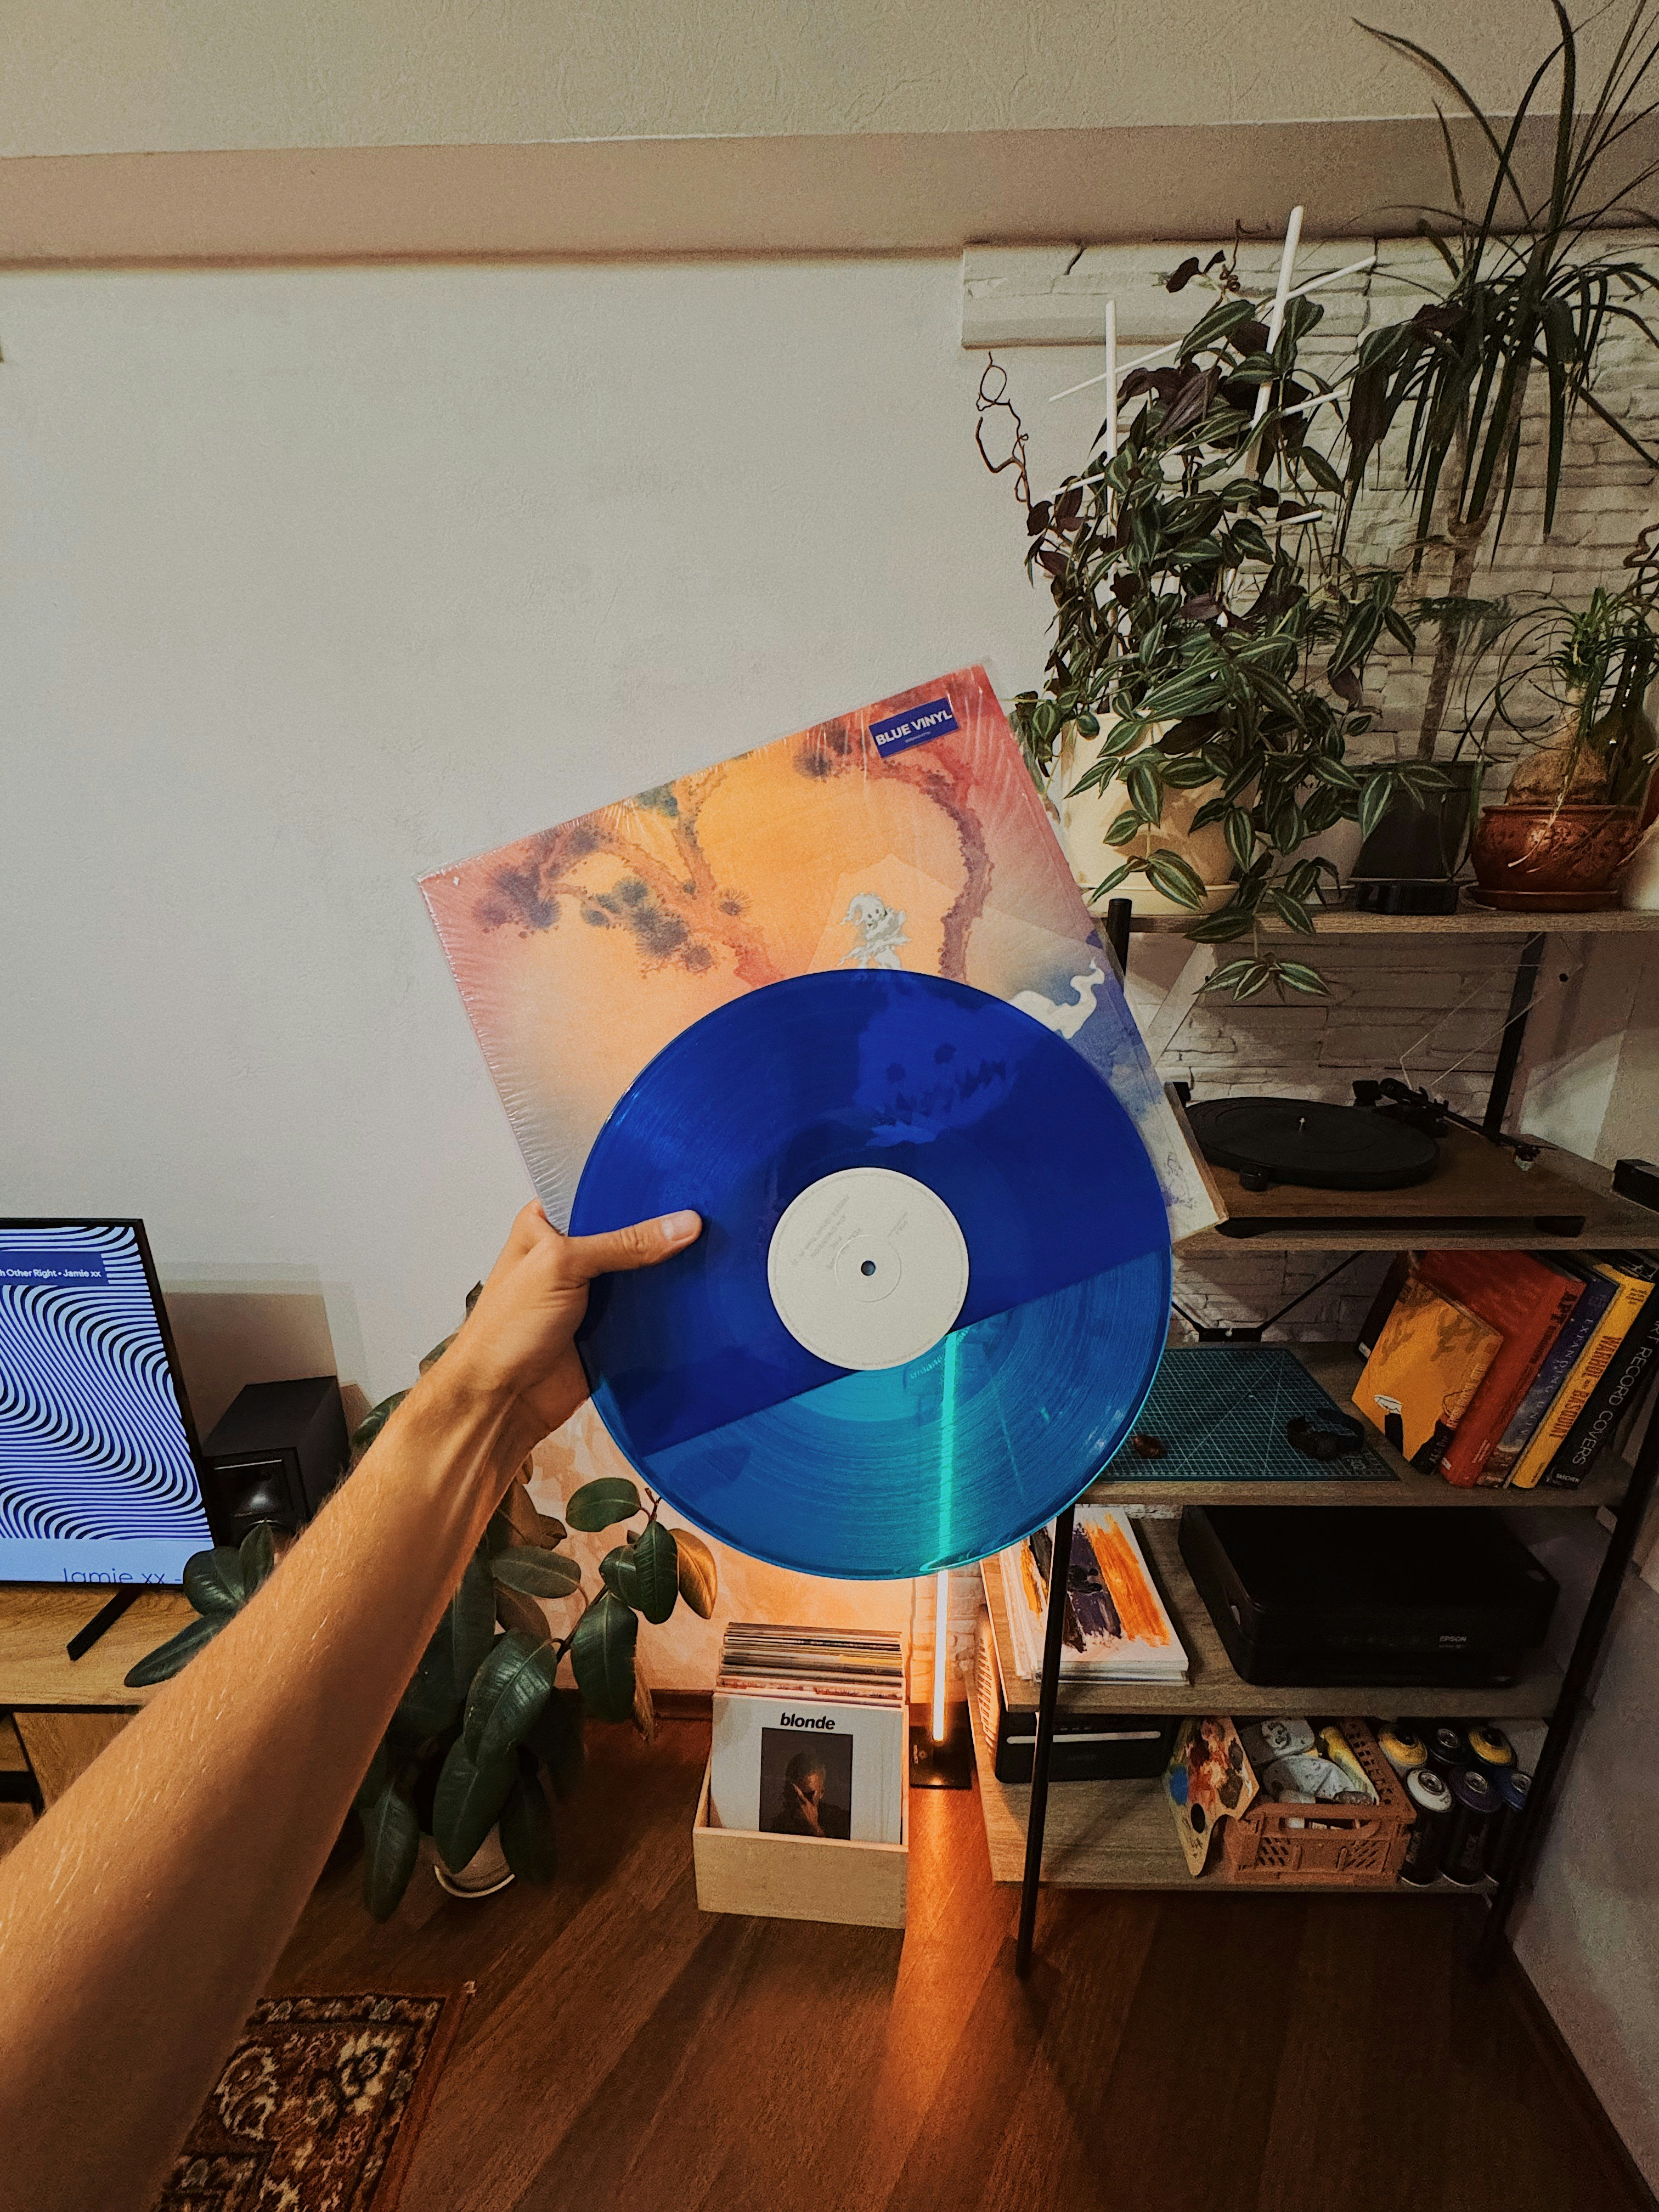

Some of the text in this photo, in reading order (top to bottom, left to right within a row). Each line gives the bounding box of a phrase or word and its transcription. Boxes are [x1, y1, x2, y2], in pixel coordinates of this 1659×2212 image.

[875, 724, 911, 746] BLUE
[911, 710, 953, 731] VINYL
[33, 1269, 58, 1279] Right
[63, 1269, 89, 1277] Jamie
[1646, 1320, 1659, 1344] RT
[1581, 1335, 1622, 1379] WARHOL
[1609, 1346, 1652, 1406] RECORD
[1549, 1389, 1589, 1440] BASQUIAT
[1572, 1410, 1613, 1465] COVERS
[780, 1712, 836, 1730] blonde
